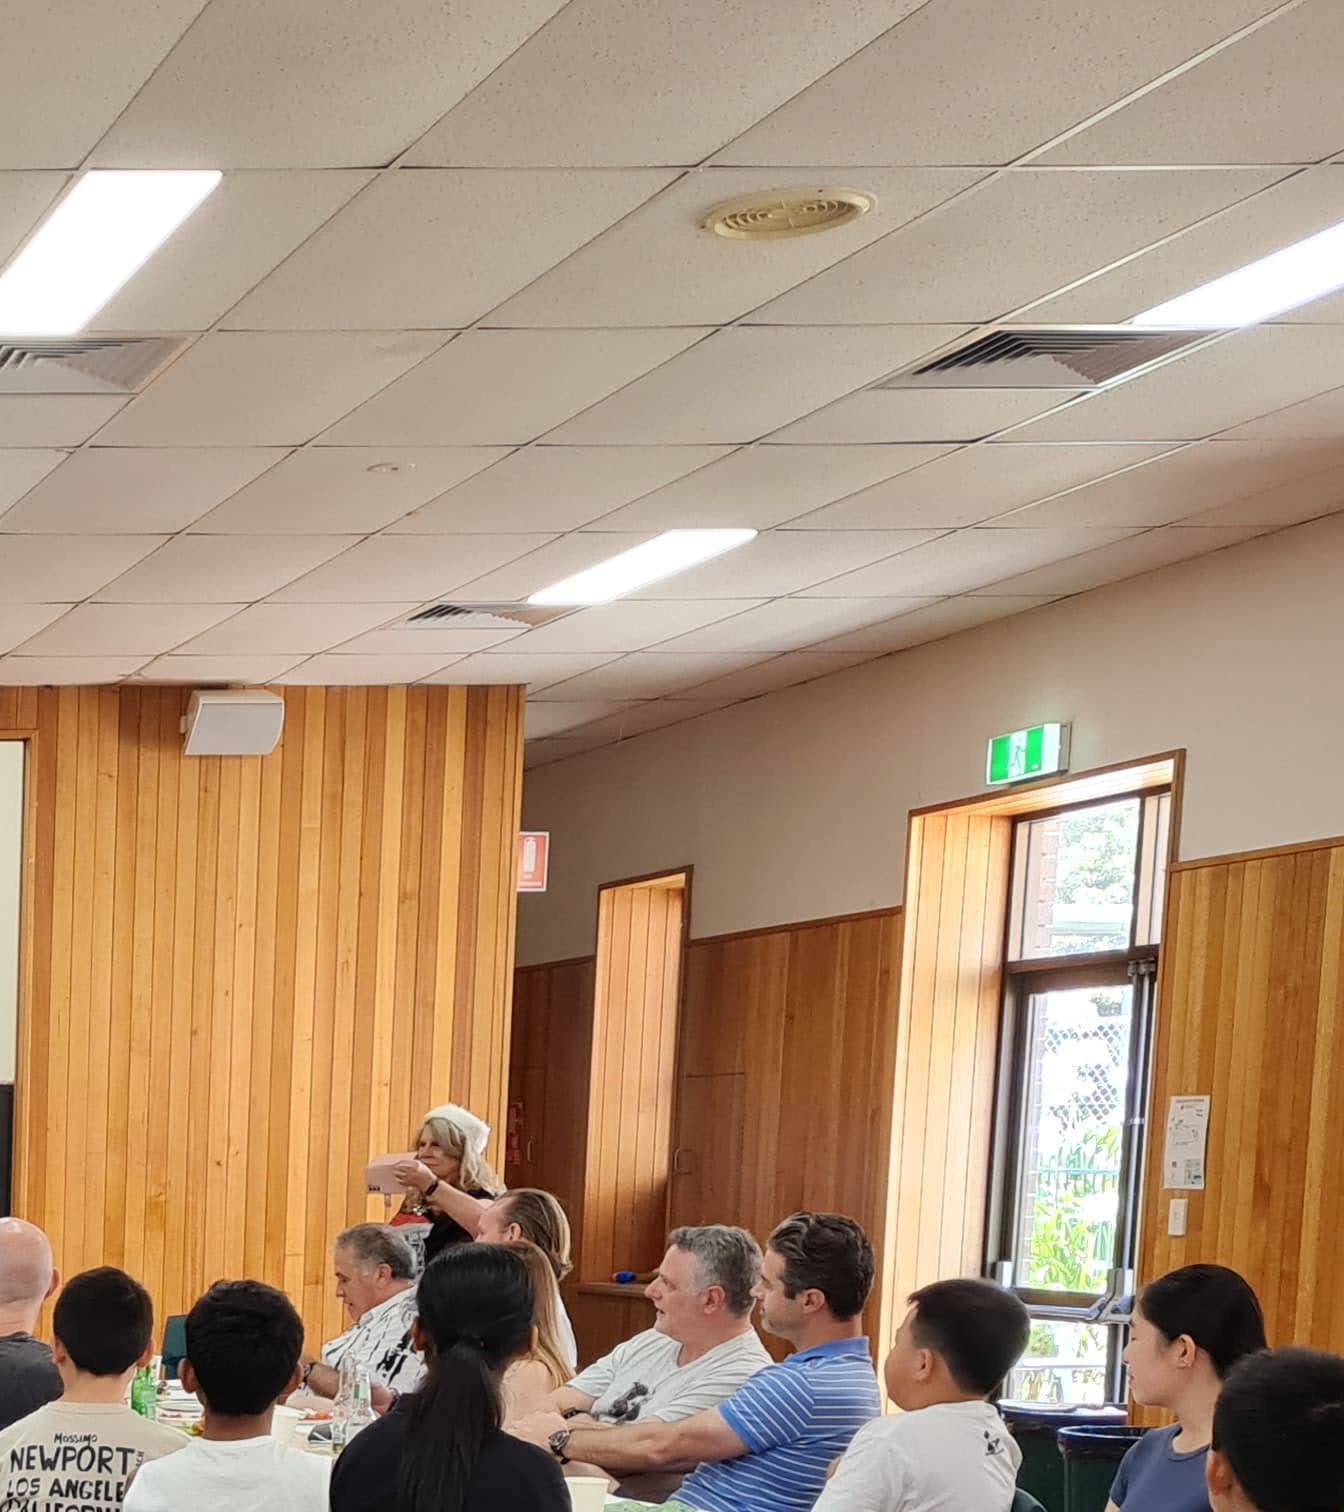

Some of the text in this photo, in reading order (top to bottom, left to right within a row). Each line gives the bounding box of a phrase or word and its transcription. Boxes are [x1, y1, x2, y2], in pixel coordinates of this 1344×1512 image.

[10, 1445, 135, 1475] NEWPORT
[6, 1477, 125, 1503] LOS ANGELE
